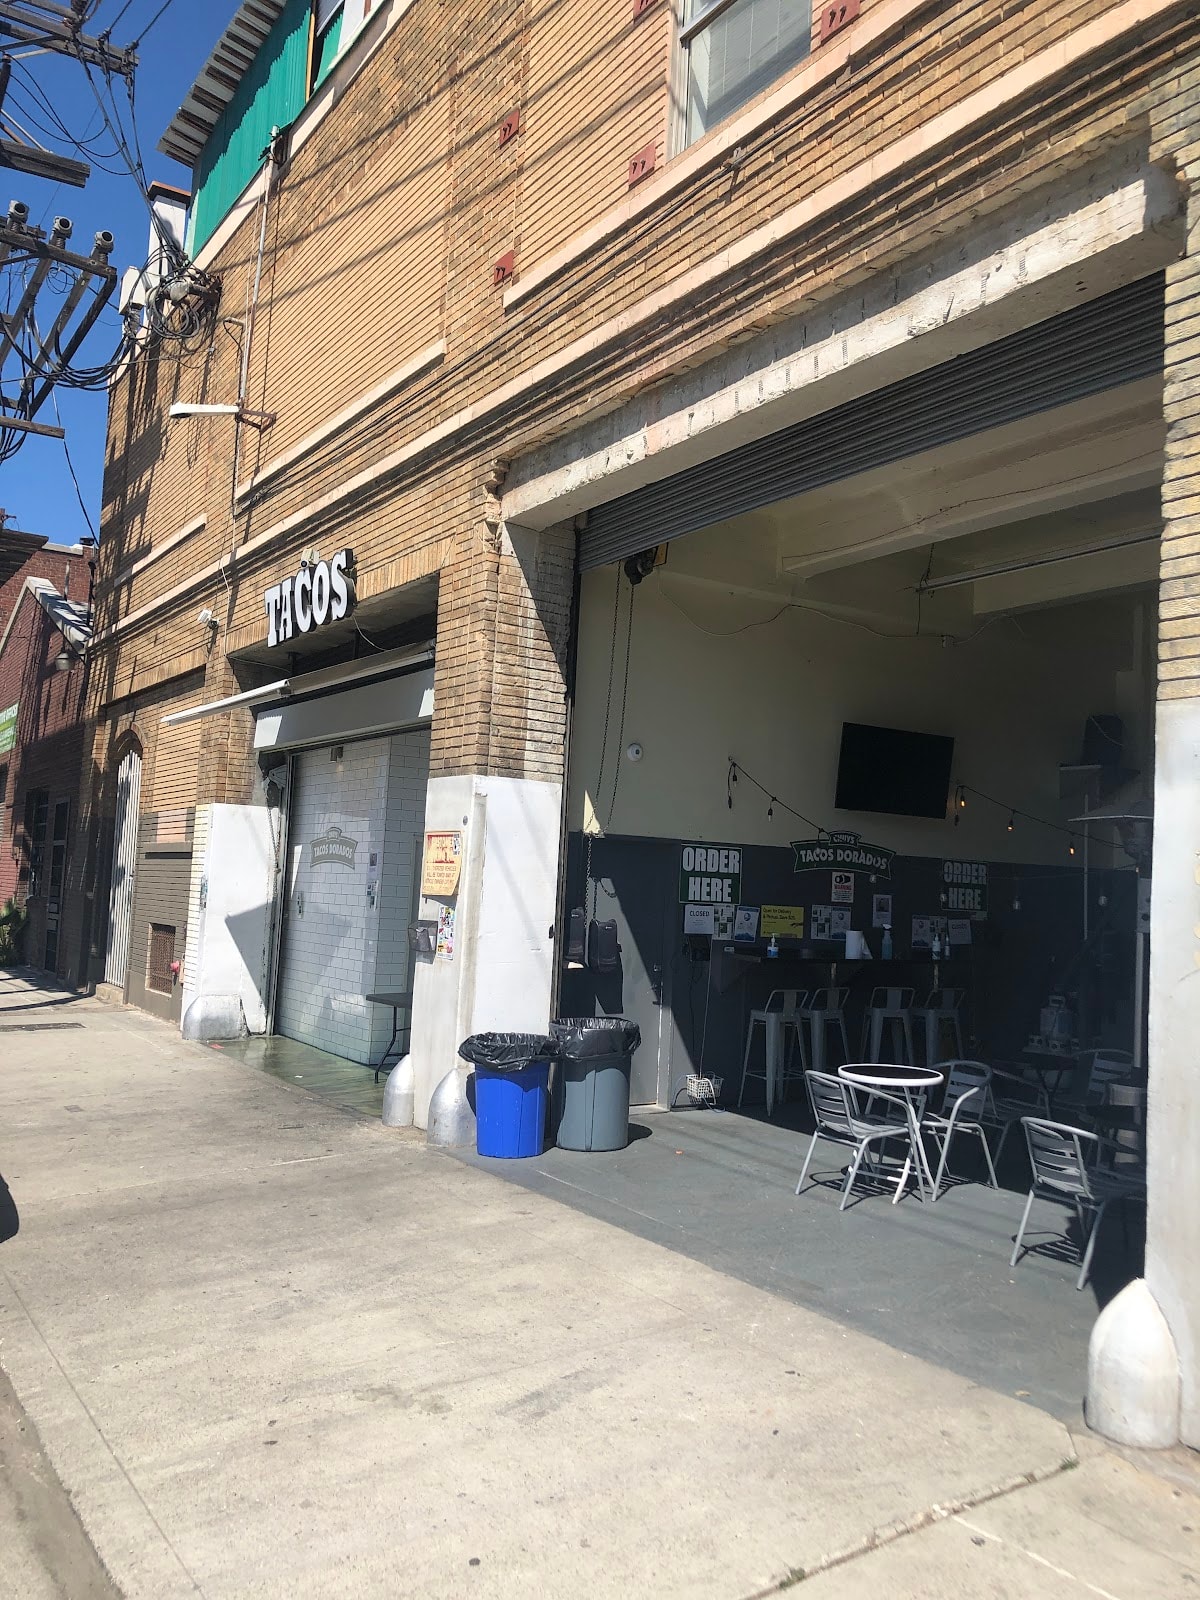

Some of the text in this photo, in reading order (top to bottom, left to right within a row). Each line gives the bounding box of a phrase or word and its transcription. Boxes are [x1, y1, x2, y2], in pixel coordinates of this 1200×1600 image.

[264, 549, 350, 647] TACOS
[313, 843, 353, 859] TACOS DORADOS
[682, 846, 740, 874] ORDER
[800, 847, 888, 870] TACOS DORADOS
[943, 861, 987, 885] ORDER
[688, 876, 732, 902] HERE
[948, 887, 981, 910] HERE
